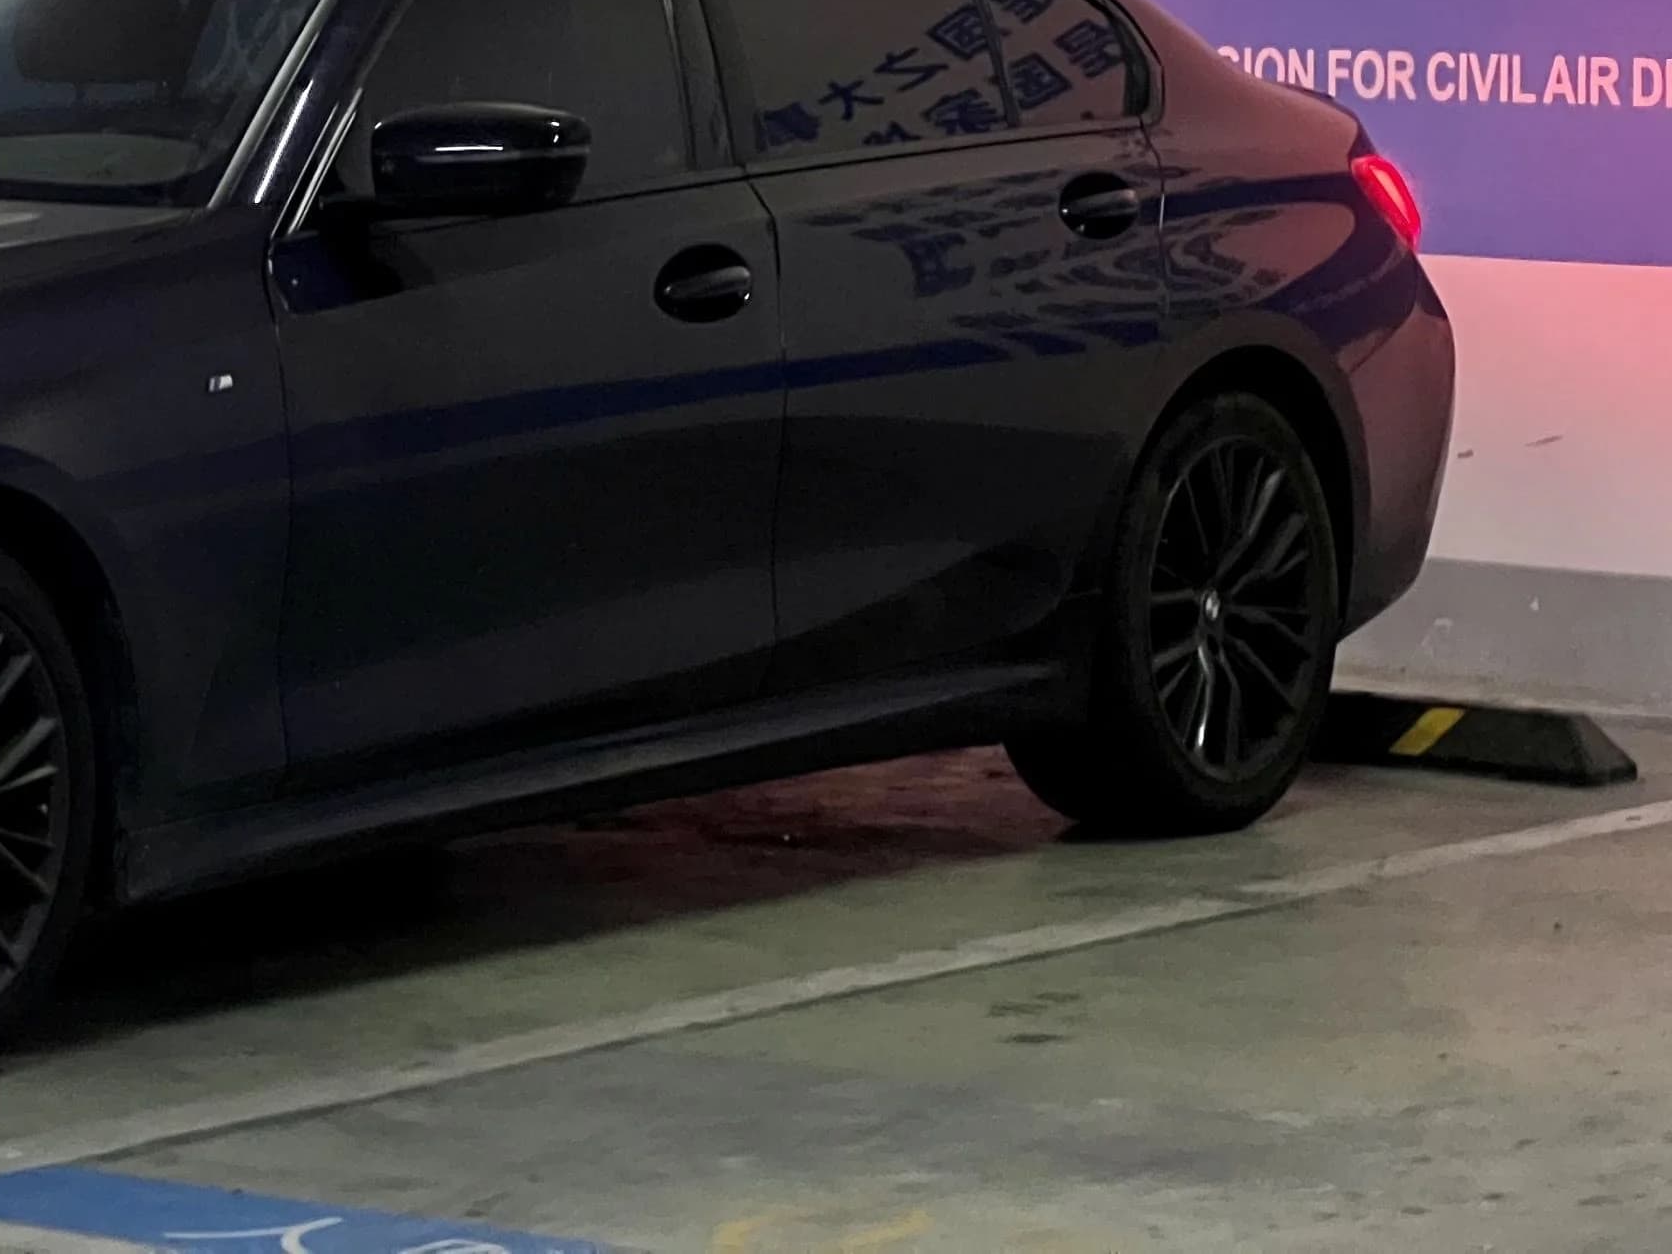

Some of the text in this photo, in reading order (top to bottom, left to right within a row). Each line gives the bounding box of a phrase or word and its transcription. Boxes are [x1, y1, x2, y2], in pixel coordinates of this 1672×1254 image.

[1328, 48, 1417, 101] FOR
[1427, 51, 1537, 103] CIVIL
[1542, 54, 1621, 107] AIR
[1632, 57, 1672, 109] D
